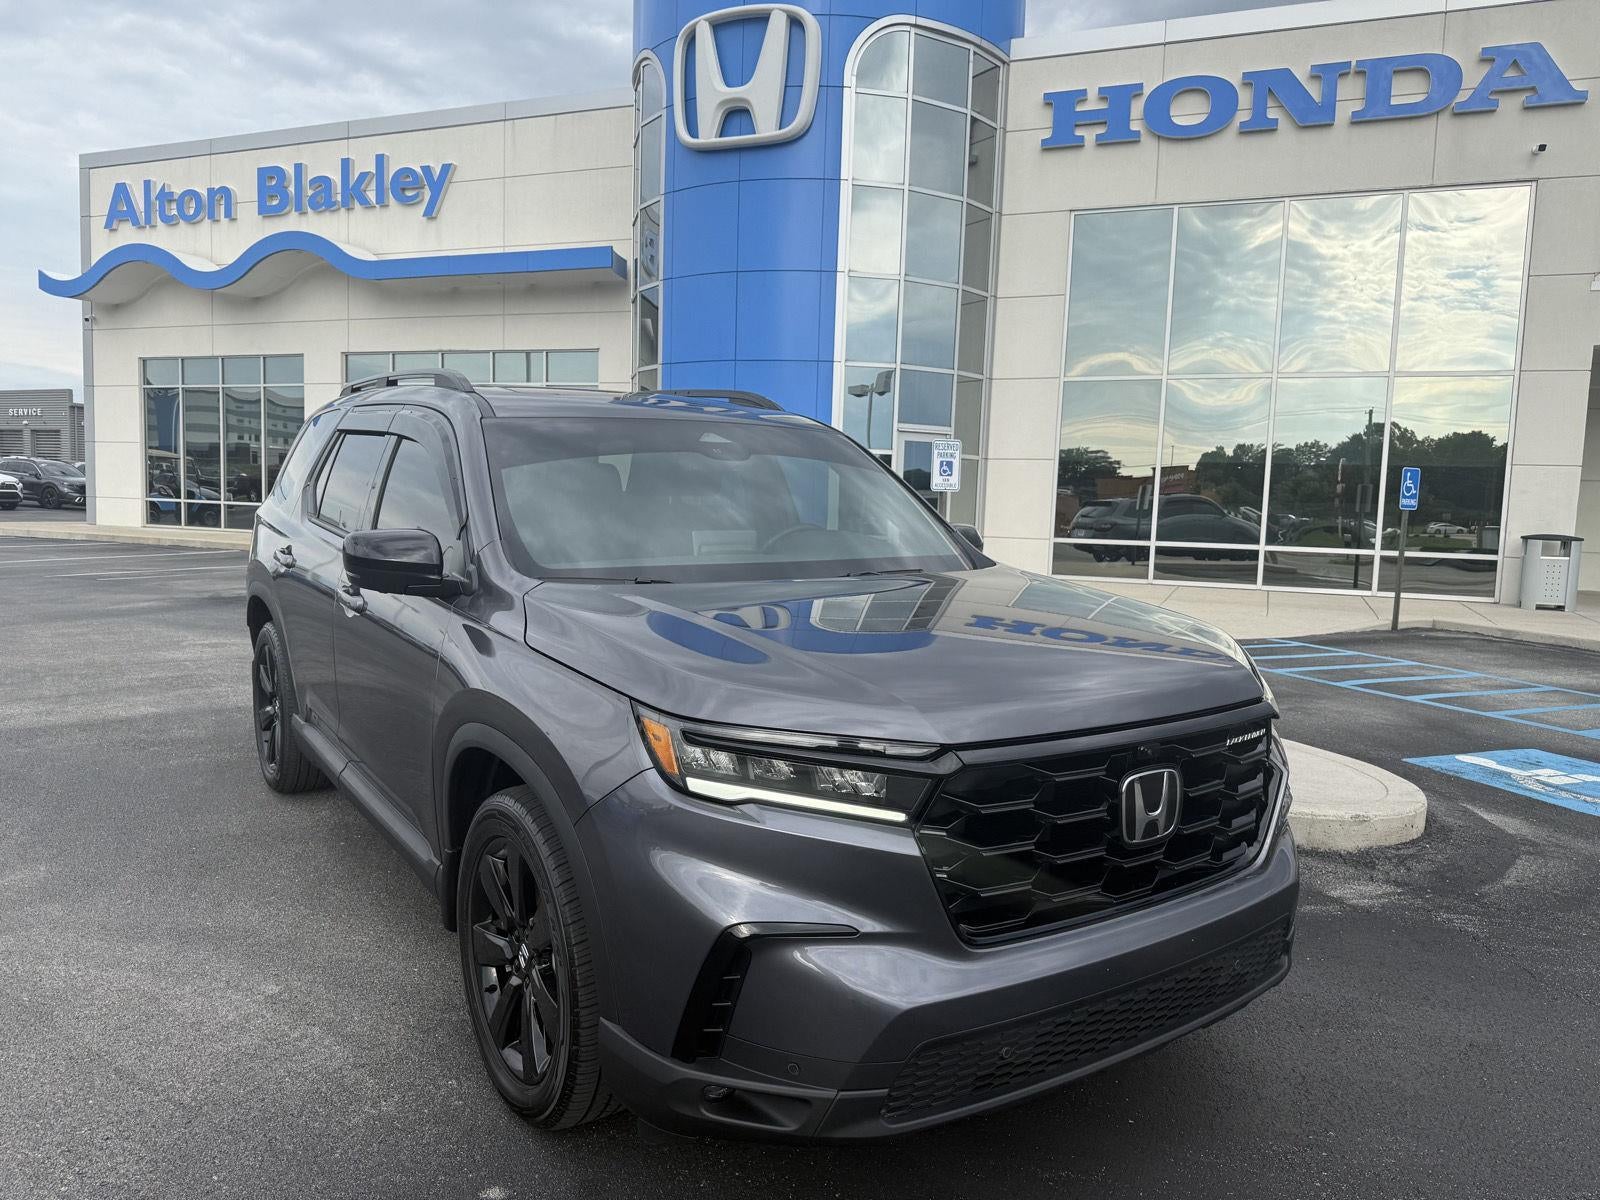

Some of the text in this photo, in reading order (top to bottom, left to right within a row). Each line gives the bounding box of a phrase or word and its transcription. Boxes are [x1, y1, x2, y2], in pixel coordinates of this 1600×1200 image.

[1041, 41, 1588, 150] HONDA
[103, 152, 455, 231] Alton Blakley
[8, 408, 42, 416] SERVICE
[935, 443, 959, 451] RESERVED
[937, 451, 957, 460] PARKING
